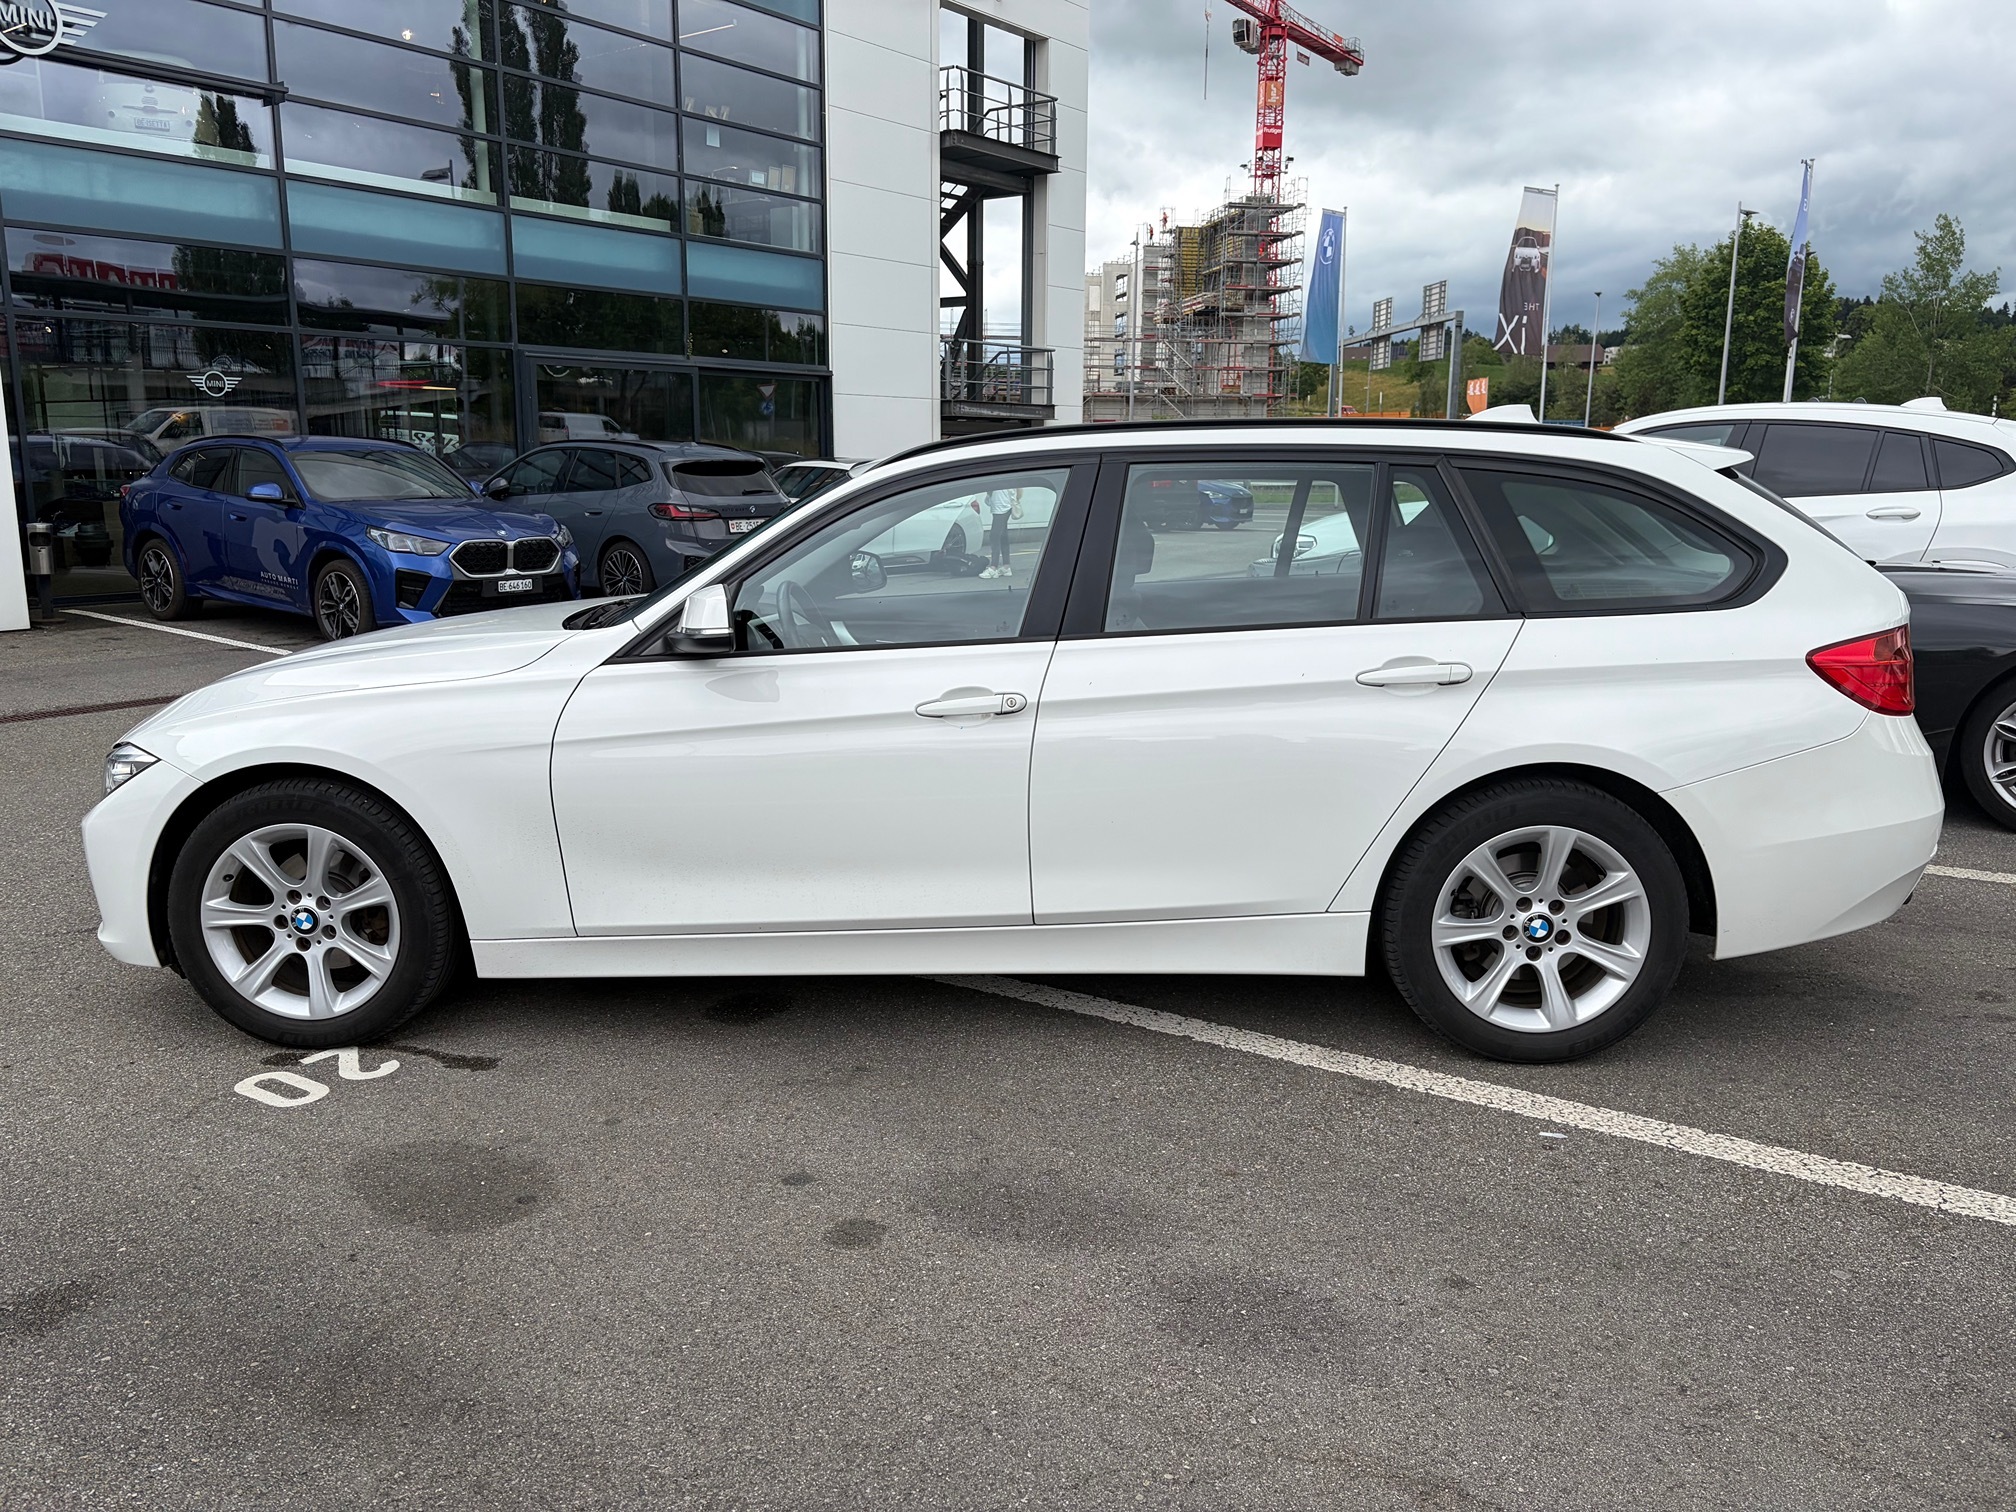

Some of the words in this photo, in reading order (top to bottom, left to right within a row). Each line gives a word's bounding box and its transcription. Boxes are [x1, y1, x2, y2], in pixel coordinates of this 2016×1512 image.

[0, 1, 56, 31] MINI
[206, 380, 224, 388] MINI
[260, 571, 277, 581] AUTO
[277, 574, 299, 586] MARTI
[499, 582, 508, 591] BE
[234, 1046, 400, 1107] 20
